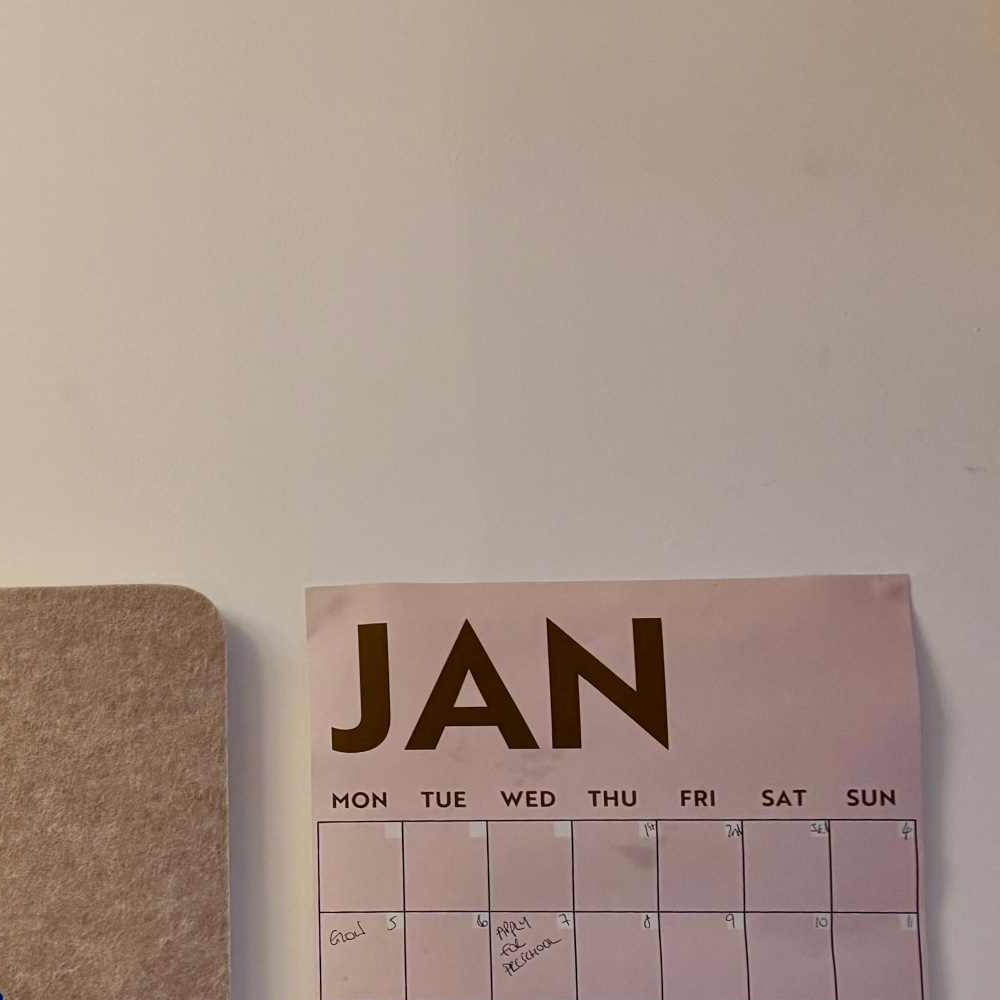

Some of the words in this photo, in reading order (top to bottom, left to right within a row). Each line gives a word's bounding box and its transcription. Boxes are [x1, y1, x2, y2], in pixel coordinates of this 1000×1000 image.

[331, 617, 669, 753] JAN
[331, 792, 388, 809] MON
[421, 791, 467, 808] TUE
[500, 791, 556, 808] WED
[588, 790, 637, 808] THU
[680, 790, 716, 807] FRI
[761, 789, 807, 807] SAT
[846, 789, 896, 806] SUN
[476, 913, 488, 928] 6
[559, 913, 571, 926] 7
[725, 913, 736, 929] 9
[815, 915, 828, 928] 10
[496, 916, 532, 941] APPLY
